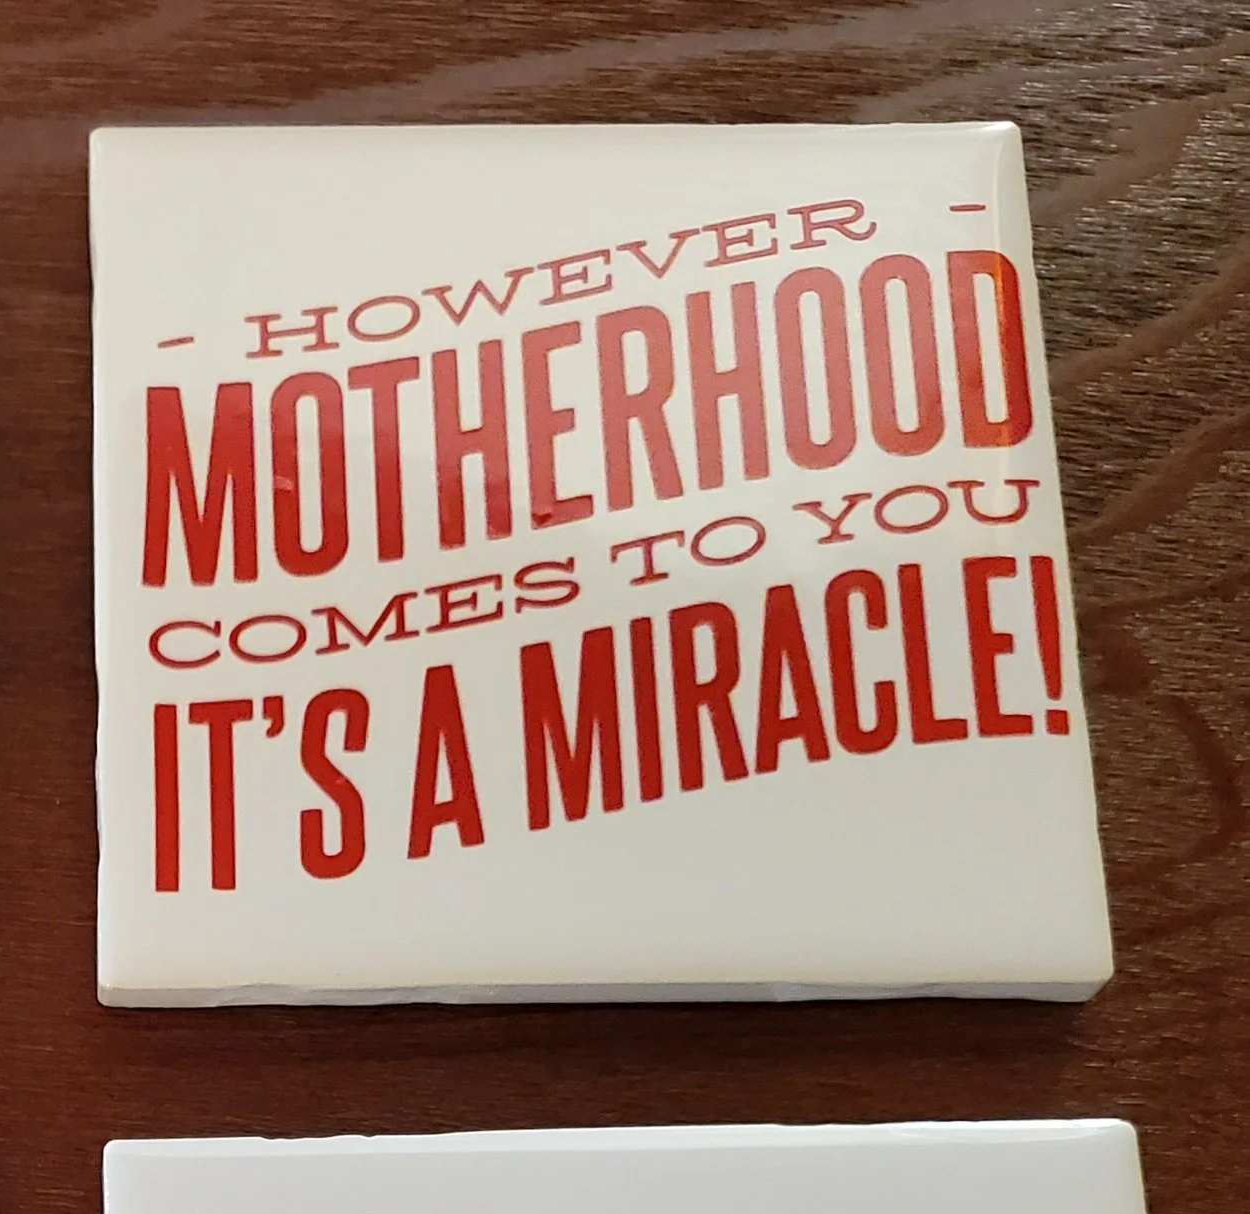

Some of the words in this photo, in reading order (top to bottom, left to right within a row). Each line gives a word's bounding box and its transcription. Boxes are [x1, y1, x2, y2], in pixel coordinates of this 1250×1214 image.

[245, 199, 877, 359] HOWEVER
[141, 249, 1034, 589] MOTHERHOOD
[147, 556, 581, 671] COMES
[609, 516, 768, 587] TO
[794, 478, 1040, 545] YOU
[407, 663, 486, 860] A
[518, 554, 1071, 833] MIRACLE!
